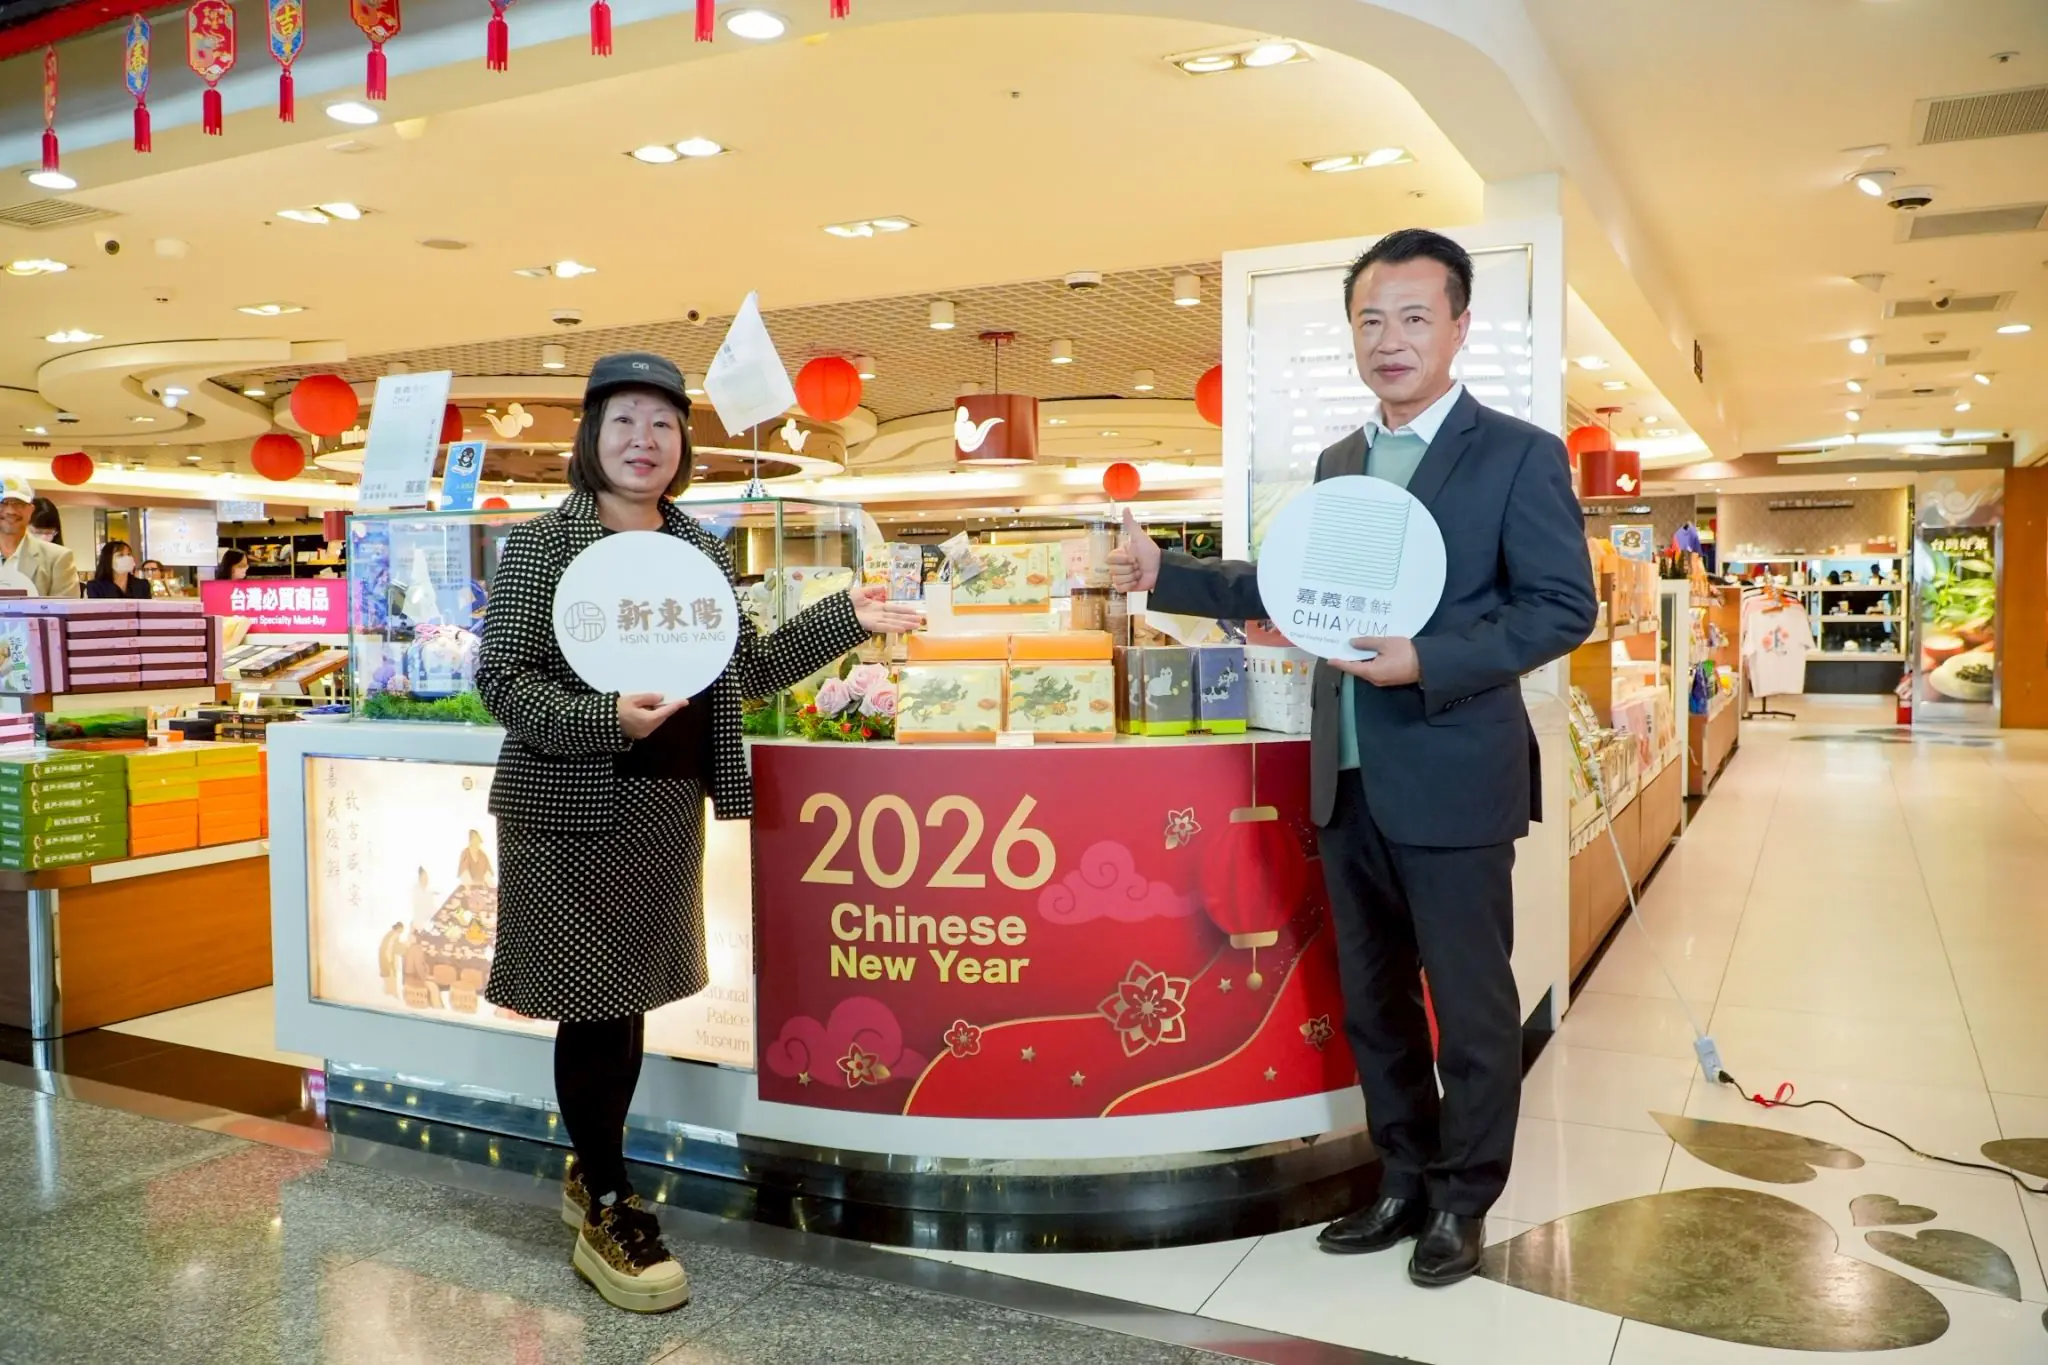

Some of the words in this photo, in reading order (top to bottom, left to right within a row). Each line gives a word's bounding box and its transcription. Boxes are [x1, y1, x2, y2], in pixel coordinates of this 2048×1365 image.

[276, 6, 299, 36] 吉
[230, 587, 329, 612] 台灣必買商品
[1296, 588, 1393, 616] 嘉義優鮮
[259, 615, 292, 626] Specialty
[294, 615, 327, 626] Must-Buy
[617, 598, 723, 631] 新東陽
[1292, 609, 1389, 637] CHIAYUM
[620, 633, 649, 644] HSIN
[655, 632, 688, 644] TUNG
[692, 631, 726, 642] YANG
[799, 792, 1056, 890] 2026
[831, 903, 1027, 946] Chinese
[830, 945, 916, 981] New
[929, 949, 1030, 983] Year
[701, 985, 749, 1004] ational
[706, 1006, 750, 1026] Palace
[696, 1029, 750, 1052] Museum
